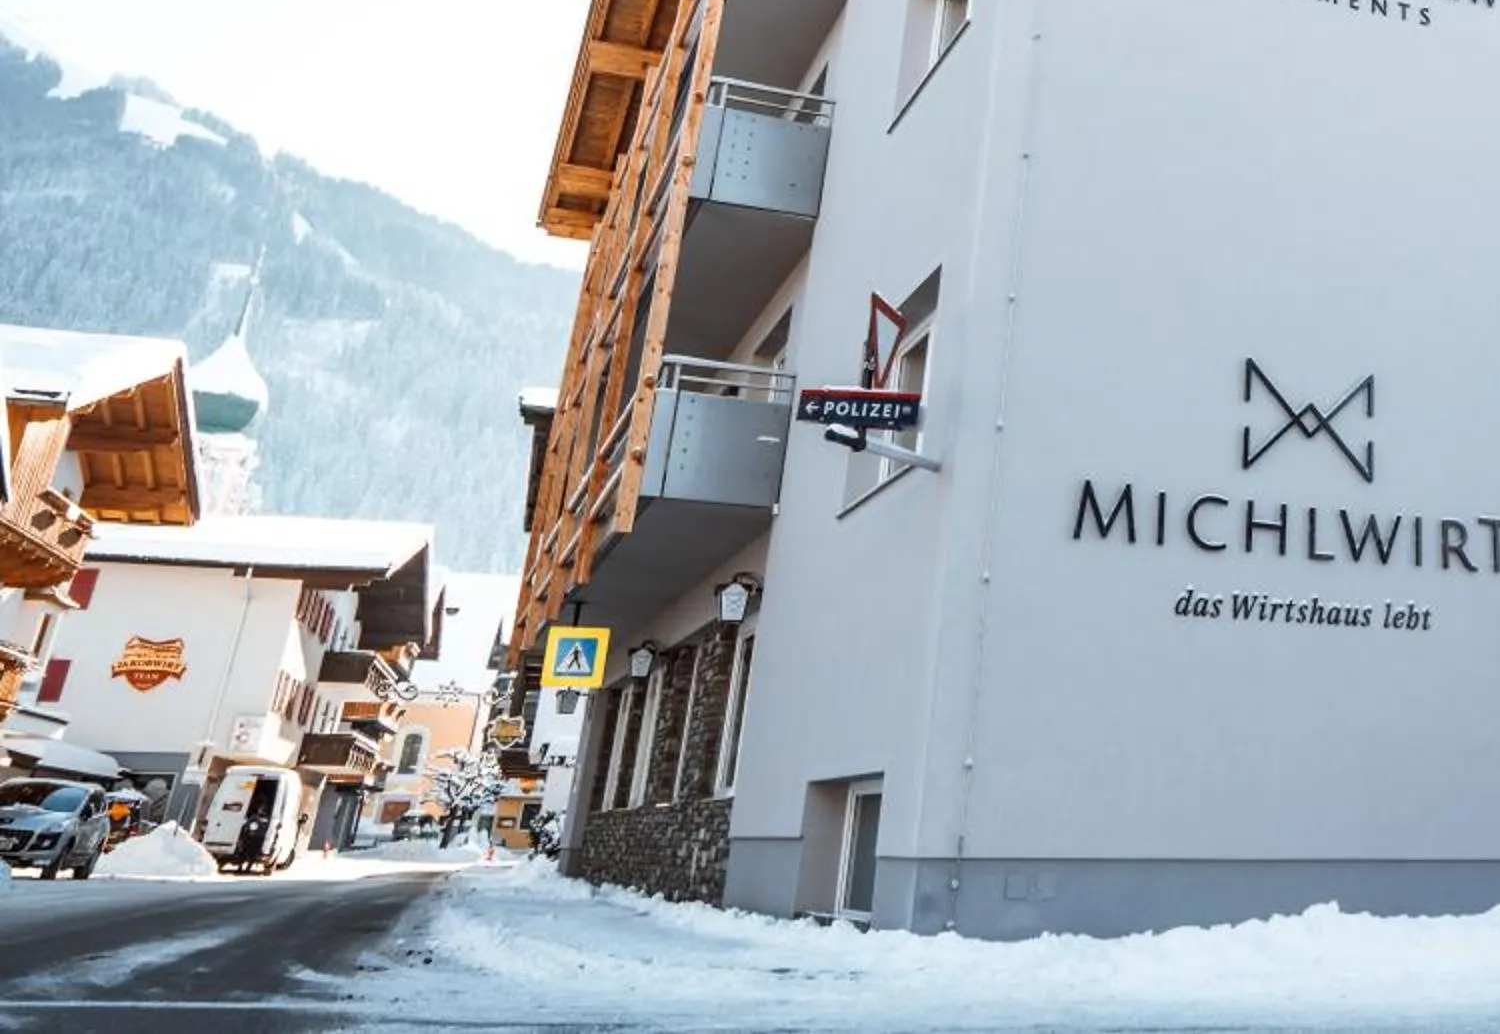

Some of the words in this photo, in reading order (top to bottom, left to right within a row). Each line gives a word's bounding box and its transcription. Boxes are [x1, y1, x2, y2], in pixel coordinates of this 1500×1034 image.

[823, 400, 901, 419] POLIZEI
[1173, 589, 1224, 619] das
[1231, 593, 1373, 628] Wirtshaus
[1383, 602, 1432, 631] lebt
